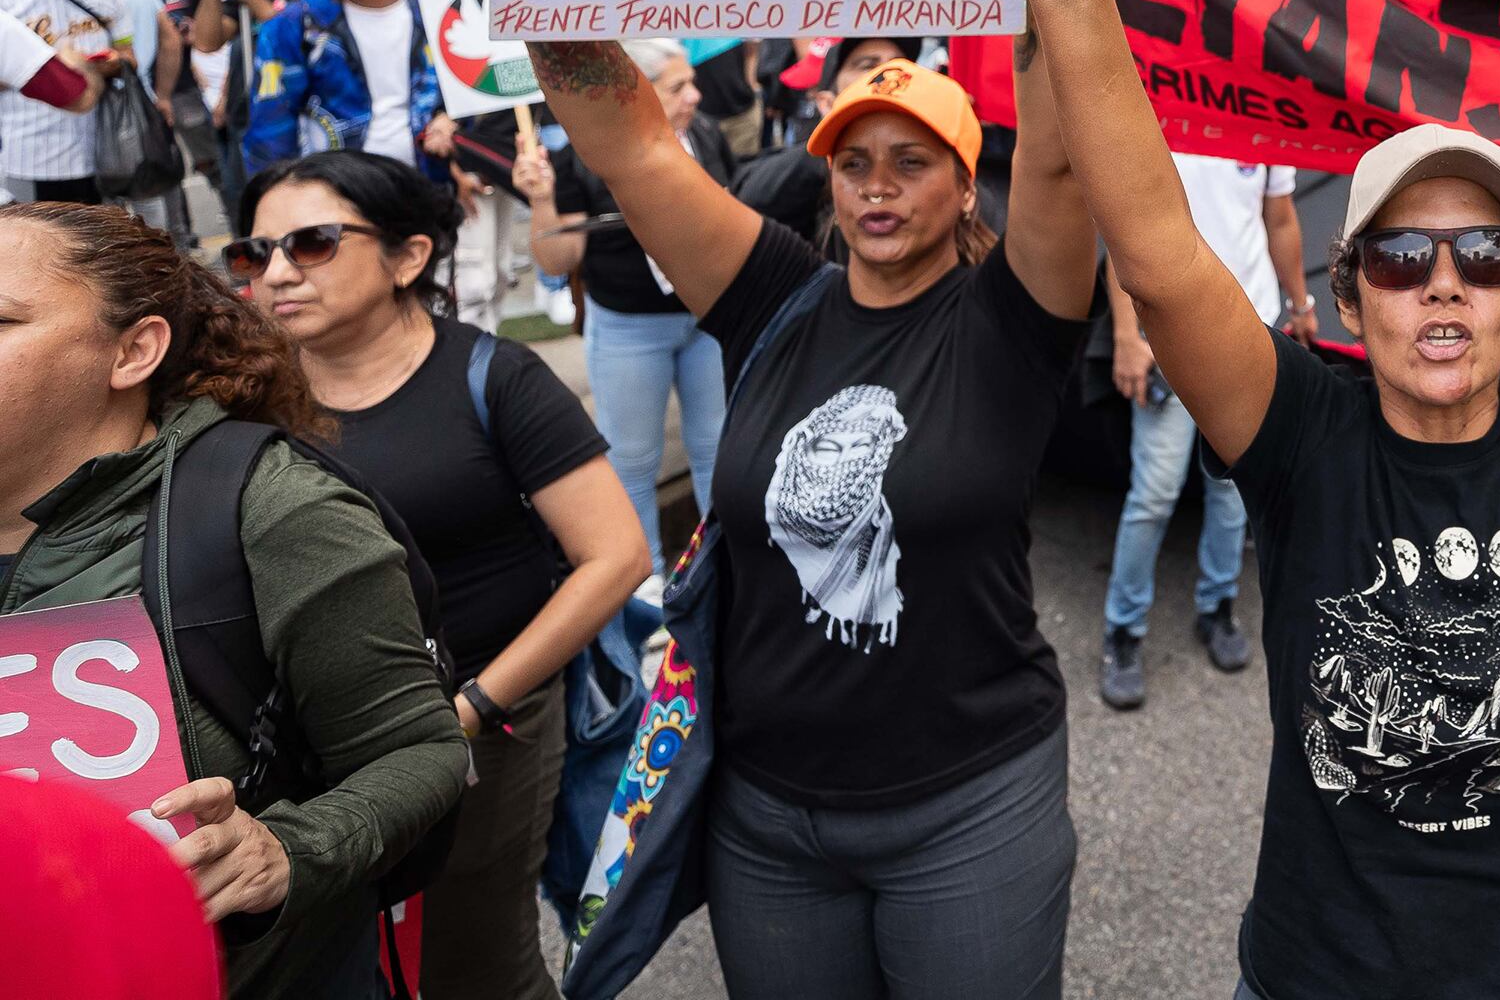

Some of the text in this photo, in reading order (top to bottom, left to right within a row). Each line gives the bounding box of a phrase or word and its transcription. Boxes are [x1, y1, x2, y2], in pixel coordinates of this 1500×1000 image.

[799, 0, 845, 31] DE
[854, 0, 1002, 29] MIRANDA
[1452, 815, 1491, 831] VIBES
